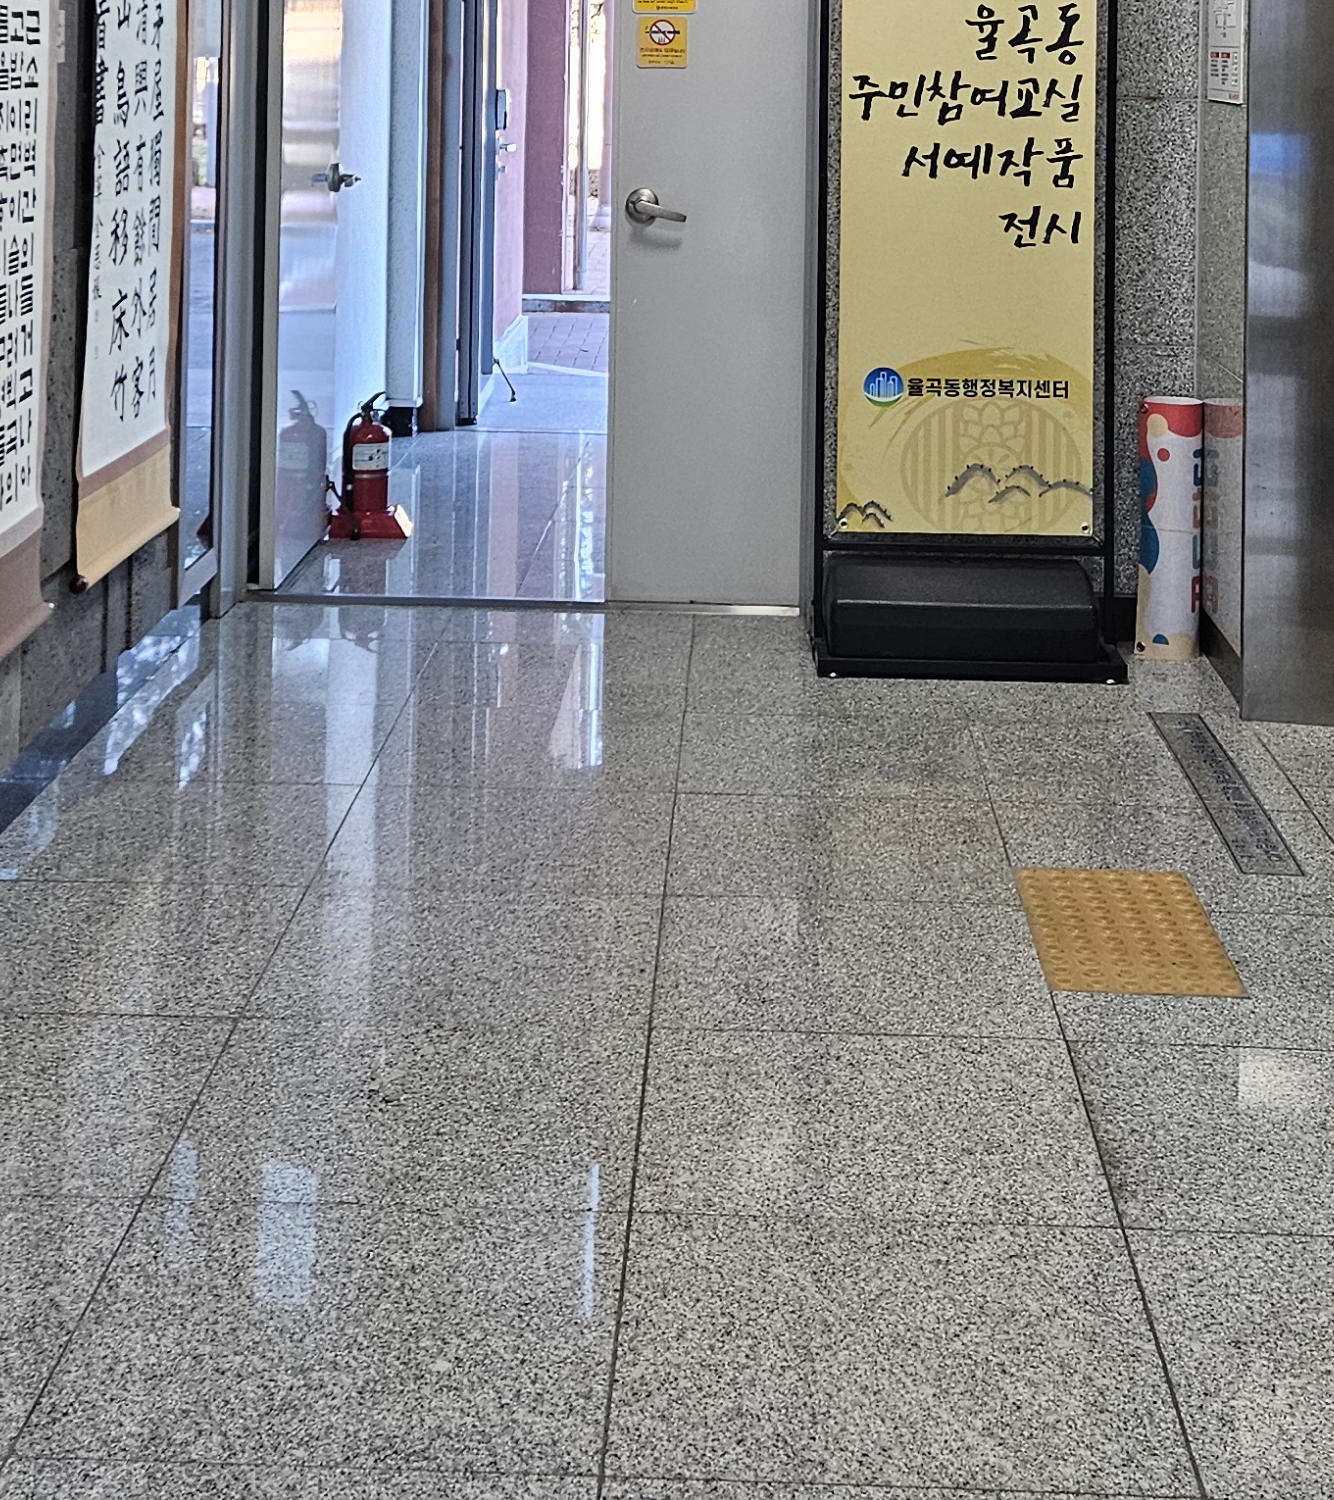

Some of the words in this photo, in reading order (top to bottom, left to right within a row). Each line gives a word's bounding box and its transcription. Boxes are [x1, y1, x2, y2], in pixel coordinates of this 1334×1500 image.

[965, 3, 1085, 65] 율곡동
[849, 71, 1084, 124] 주민참여교실
[902, 137, 1084, 189] 서예작품
[999, 206, 1081, 248] 전시
[907, 377, 1070, 400] 율곡동행정복지센터
